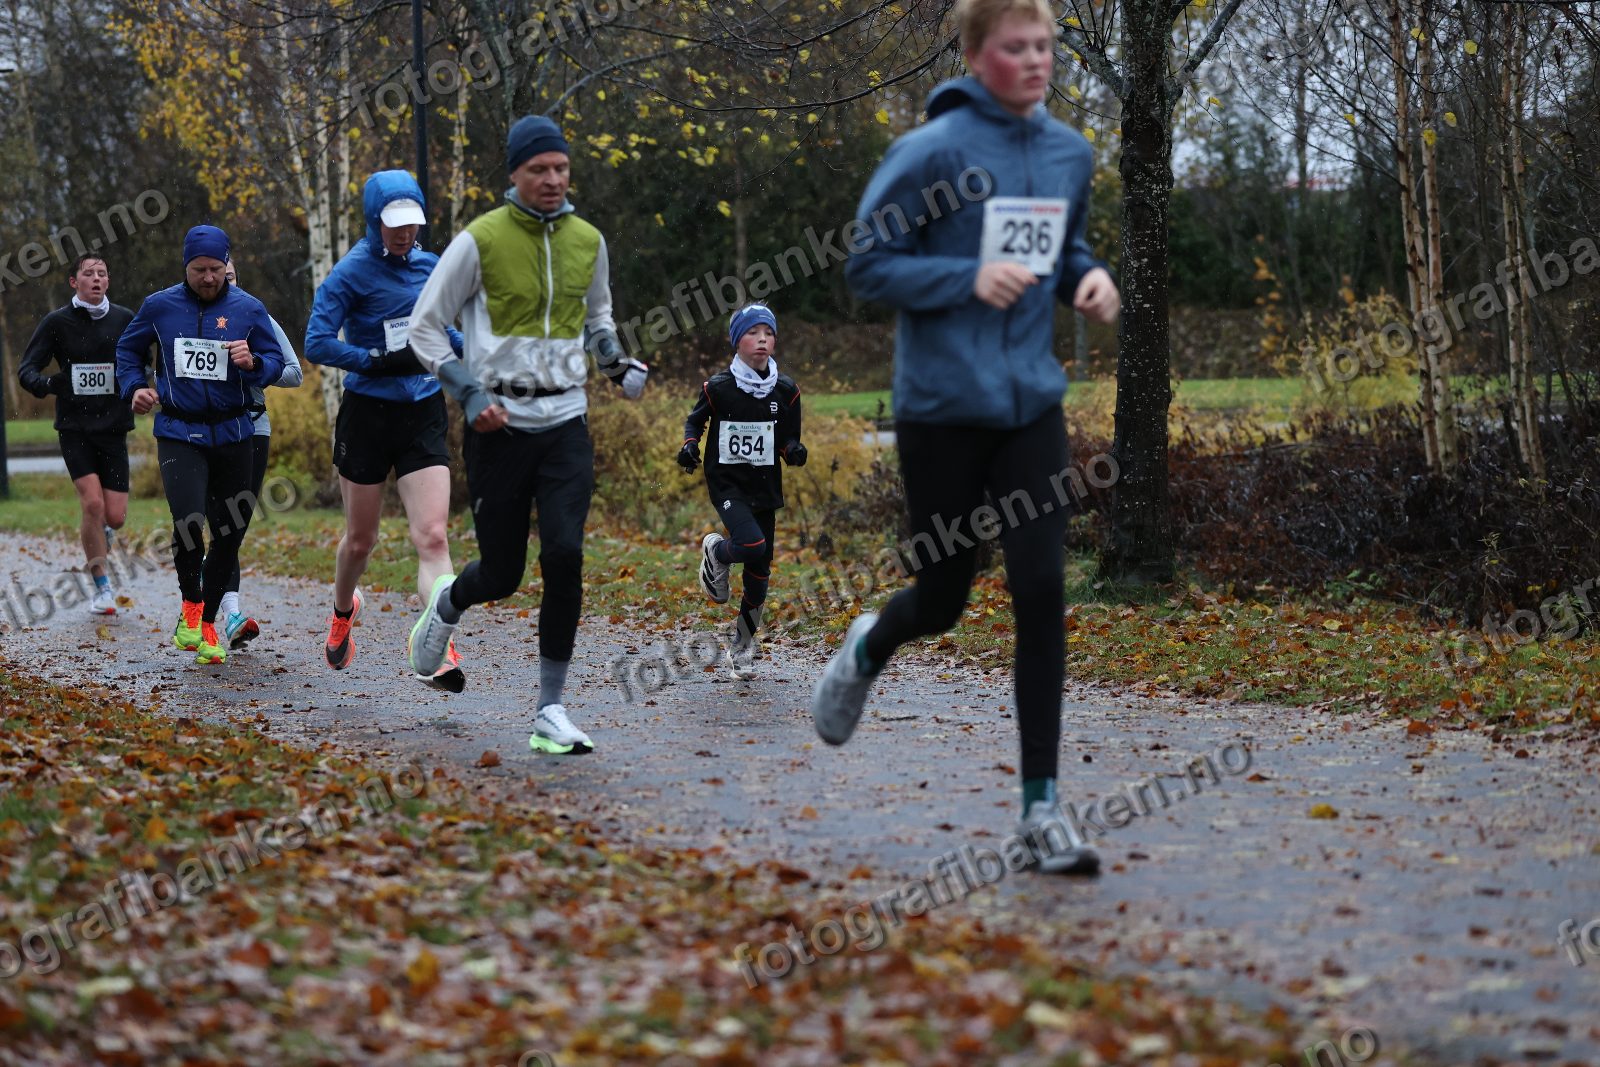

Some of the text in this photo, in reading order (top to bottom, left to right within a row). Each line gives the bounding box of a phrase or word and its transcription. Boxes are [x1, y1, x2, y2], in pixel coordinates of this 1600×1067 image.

[1001, 220, 1052, 255] 236
[185, 350, 217, 371] 769
[80, 372, 105, 387] 380
[729, 434, 764, 456] 654
